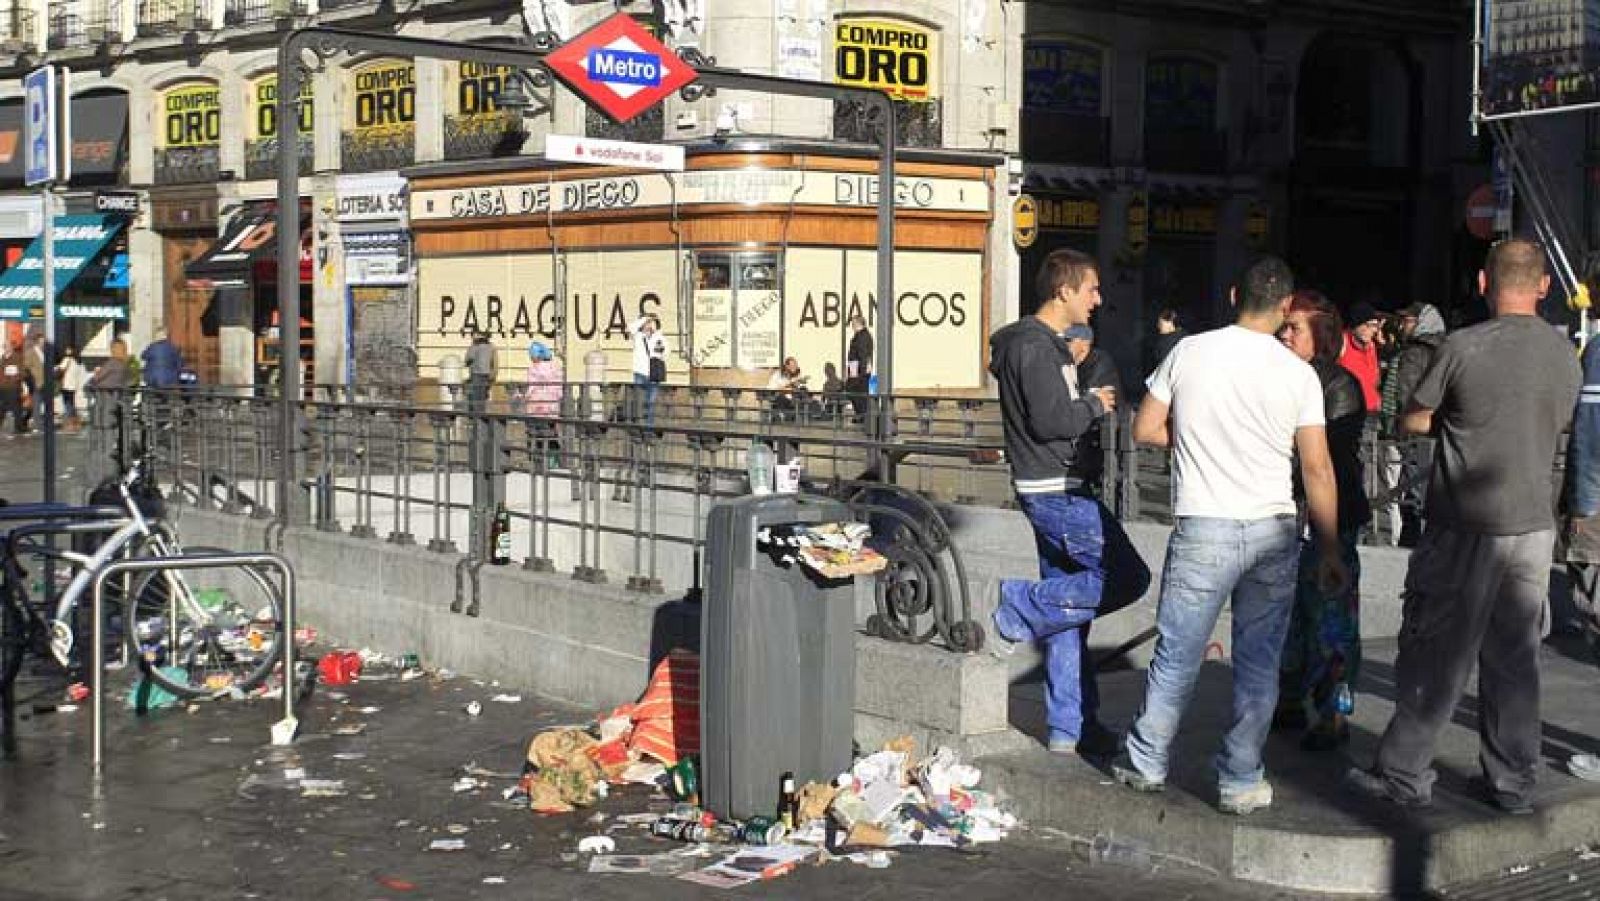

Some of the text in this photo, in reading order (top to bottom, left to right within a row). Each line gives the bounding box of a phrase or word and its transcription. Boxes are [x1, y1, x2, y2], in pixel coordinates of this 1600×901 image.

[837, 25, 928, 50] COMPRO
[595, 53, 655, 79] Metro
[836, 45, 928, 86] ORO
[356, 86, 415, 125] ORO
[459, 76, 504, 114] OR
[167, 109, 219, 144] ORO
[258, 98, 313, 136] OO
[590, 147, 640, 160] vodafone
[336, 194, 384, 214] LOTERIA
[450, 187, 506, 217] CASA
[520, 187, 550, 214] DE
[563, 179, 638, 211] DIEGO
[834, 174, 933, 208] DIEGO
[439, 293, 661, 341] PARAGUAS
[798, 291, 966, 328] ABANCOS
